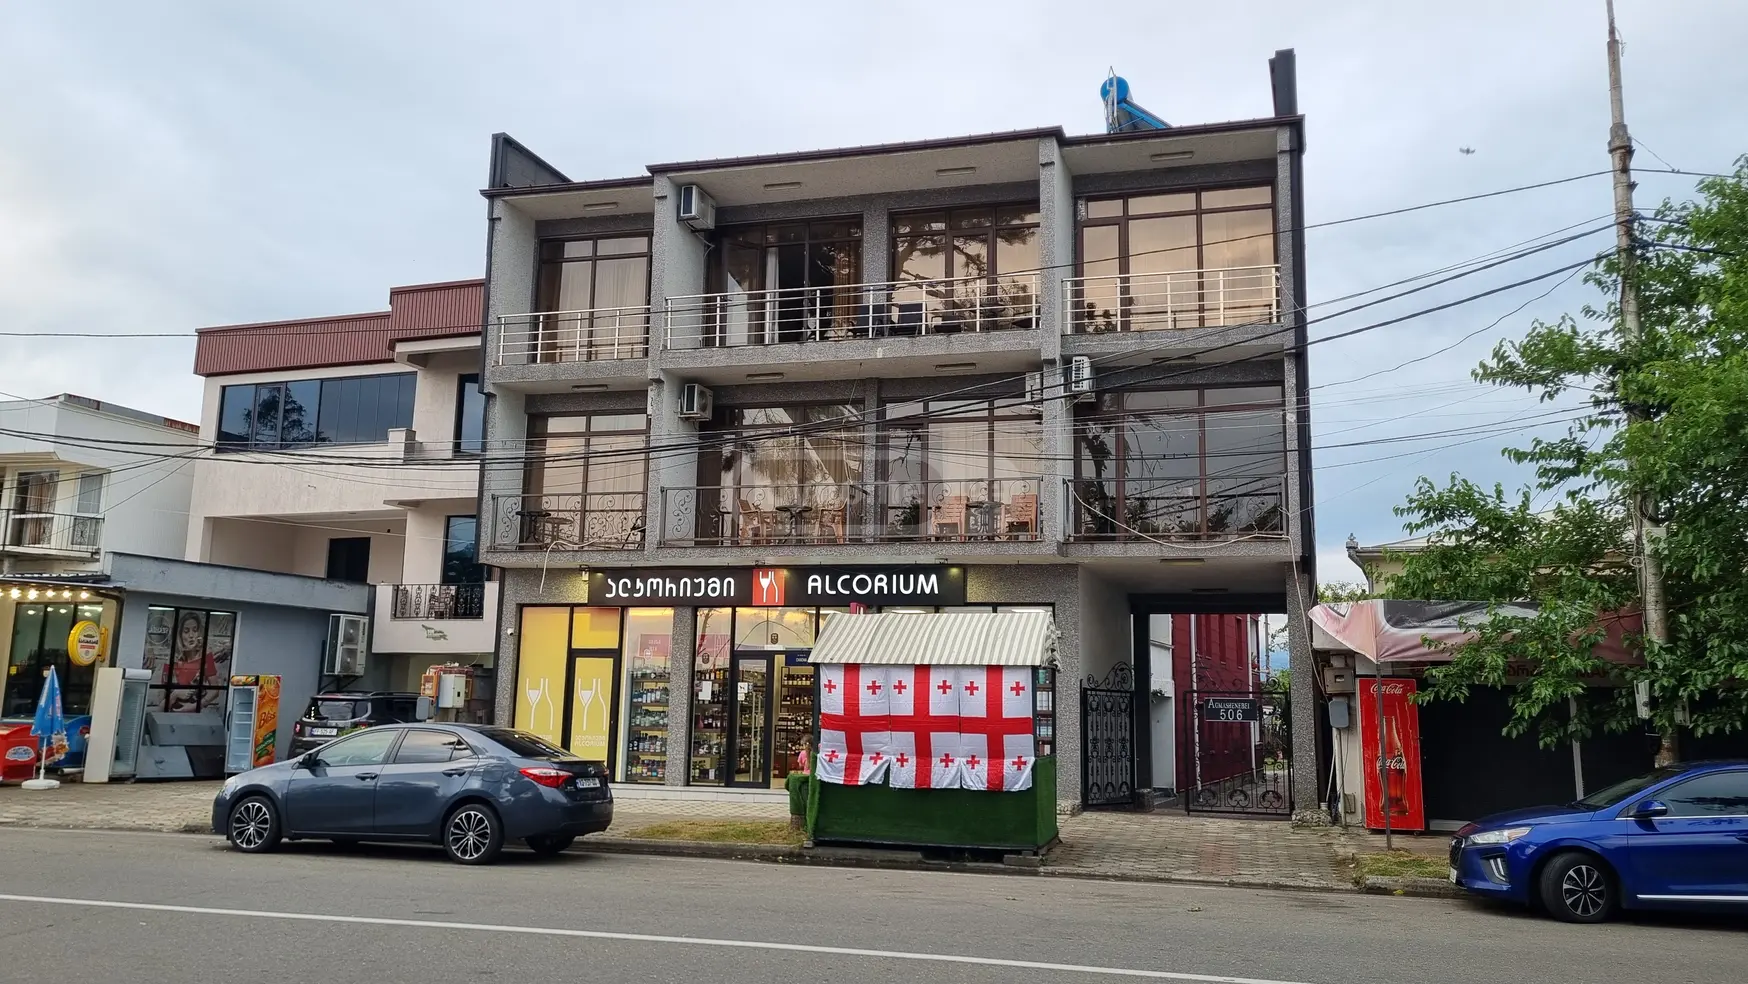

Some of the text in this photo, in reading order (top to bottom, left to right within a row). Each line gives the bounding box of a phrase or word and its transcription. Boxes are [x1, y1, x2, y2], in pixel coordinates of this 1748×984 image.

[605, 577, 735, 598] ალკორიუმი
[807, 573, 939, 596] ALCORIUM
[1220, 709, 1243, 720] 506
